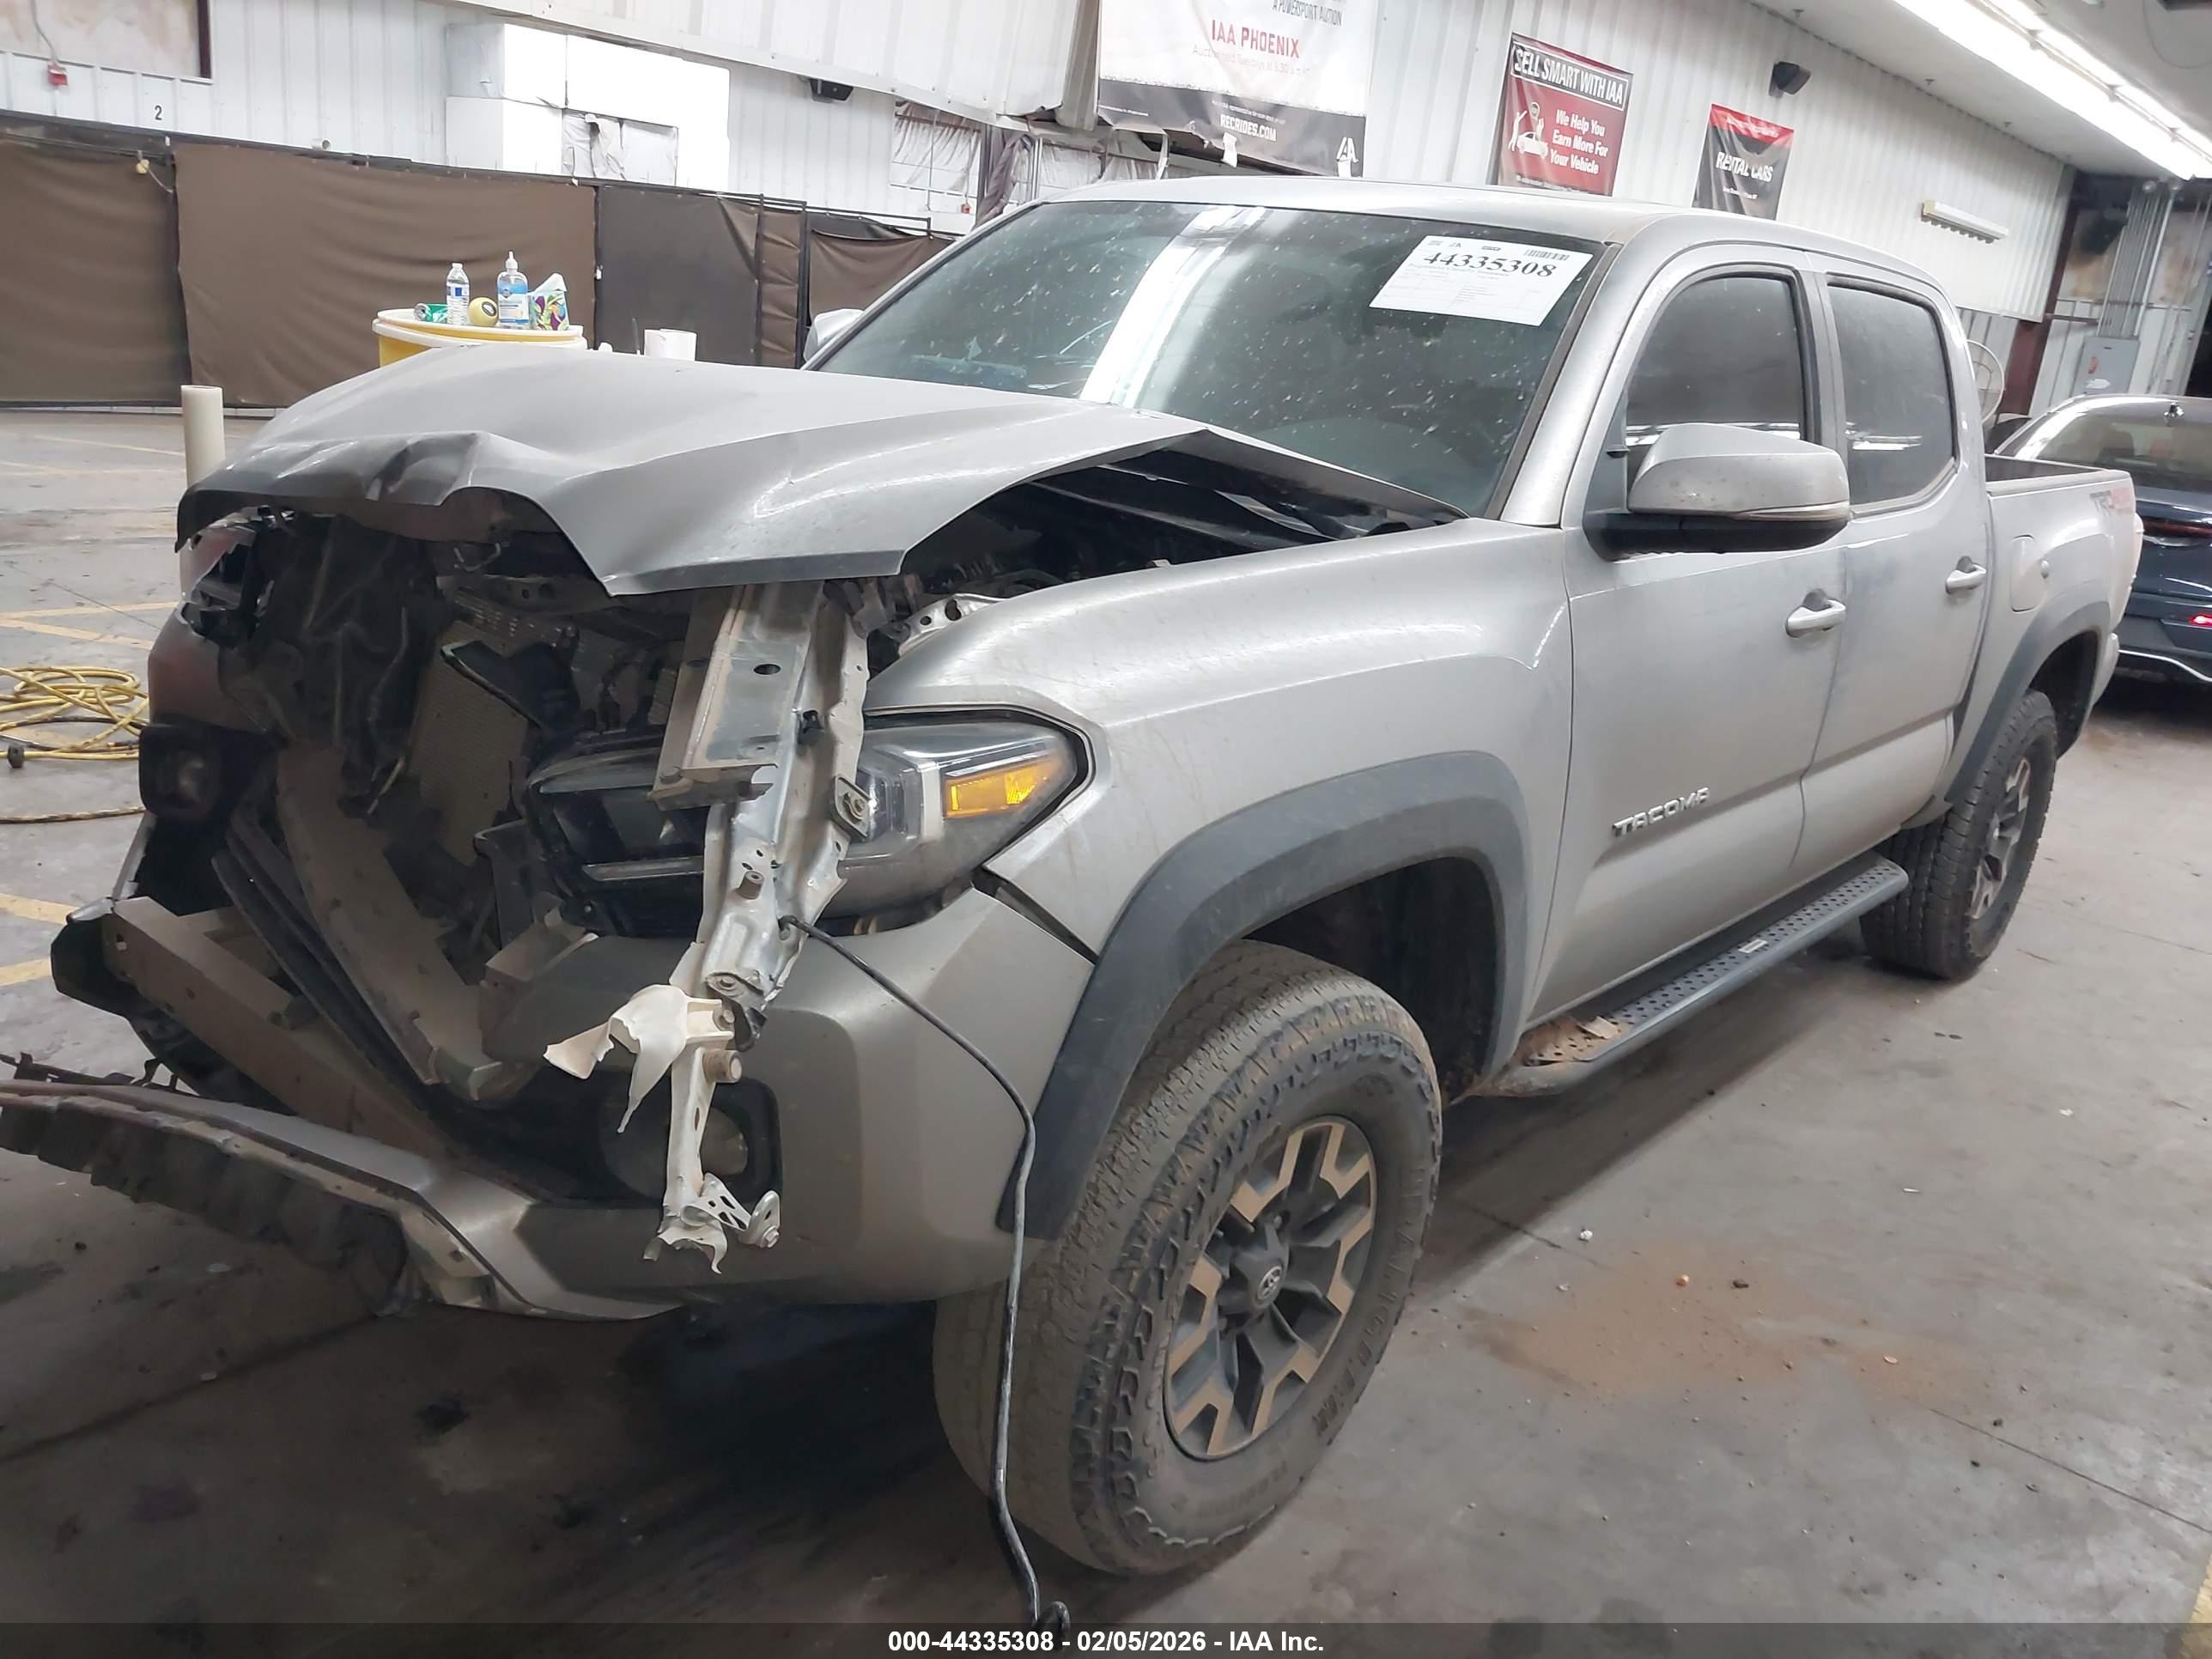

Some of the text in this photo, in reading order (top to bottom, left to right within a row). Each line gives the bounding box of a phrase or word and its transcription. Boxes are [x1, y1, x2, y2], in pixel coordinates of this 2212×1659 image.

[1278, 1, 1318, 21] POWERSPORT
[1319, 6, 1343, 27] AUCTION
[1212, 20, 1300, 58] IAA PHOENIX
[1514, 48, 1625, 105] SELL SMART WITH IAA
[155, 105, 162, 120] 2
[1556, 109, 1606, 137] We Help You
[1220, 113, 1278, 142] RECRIDES.COM
[1552, 129, 1609, 157] Earn More For
[1549, 148, 1600, 175] Your Vehicle
[1750, 165, 1774, 183] CARS
[1423, 252, 1557, 277] 44335308
[1612, 787, 1709, 836] TACOMA
